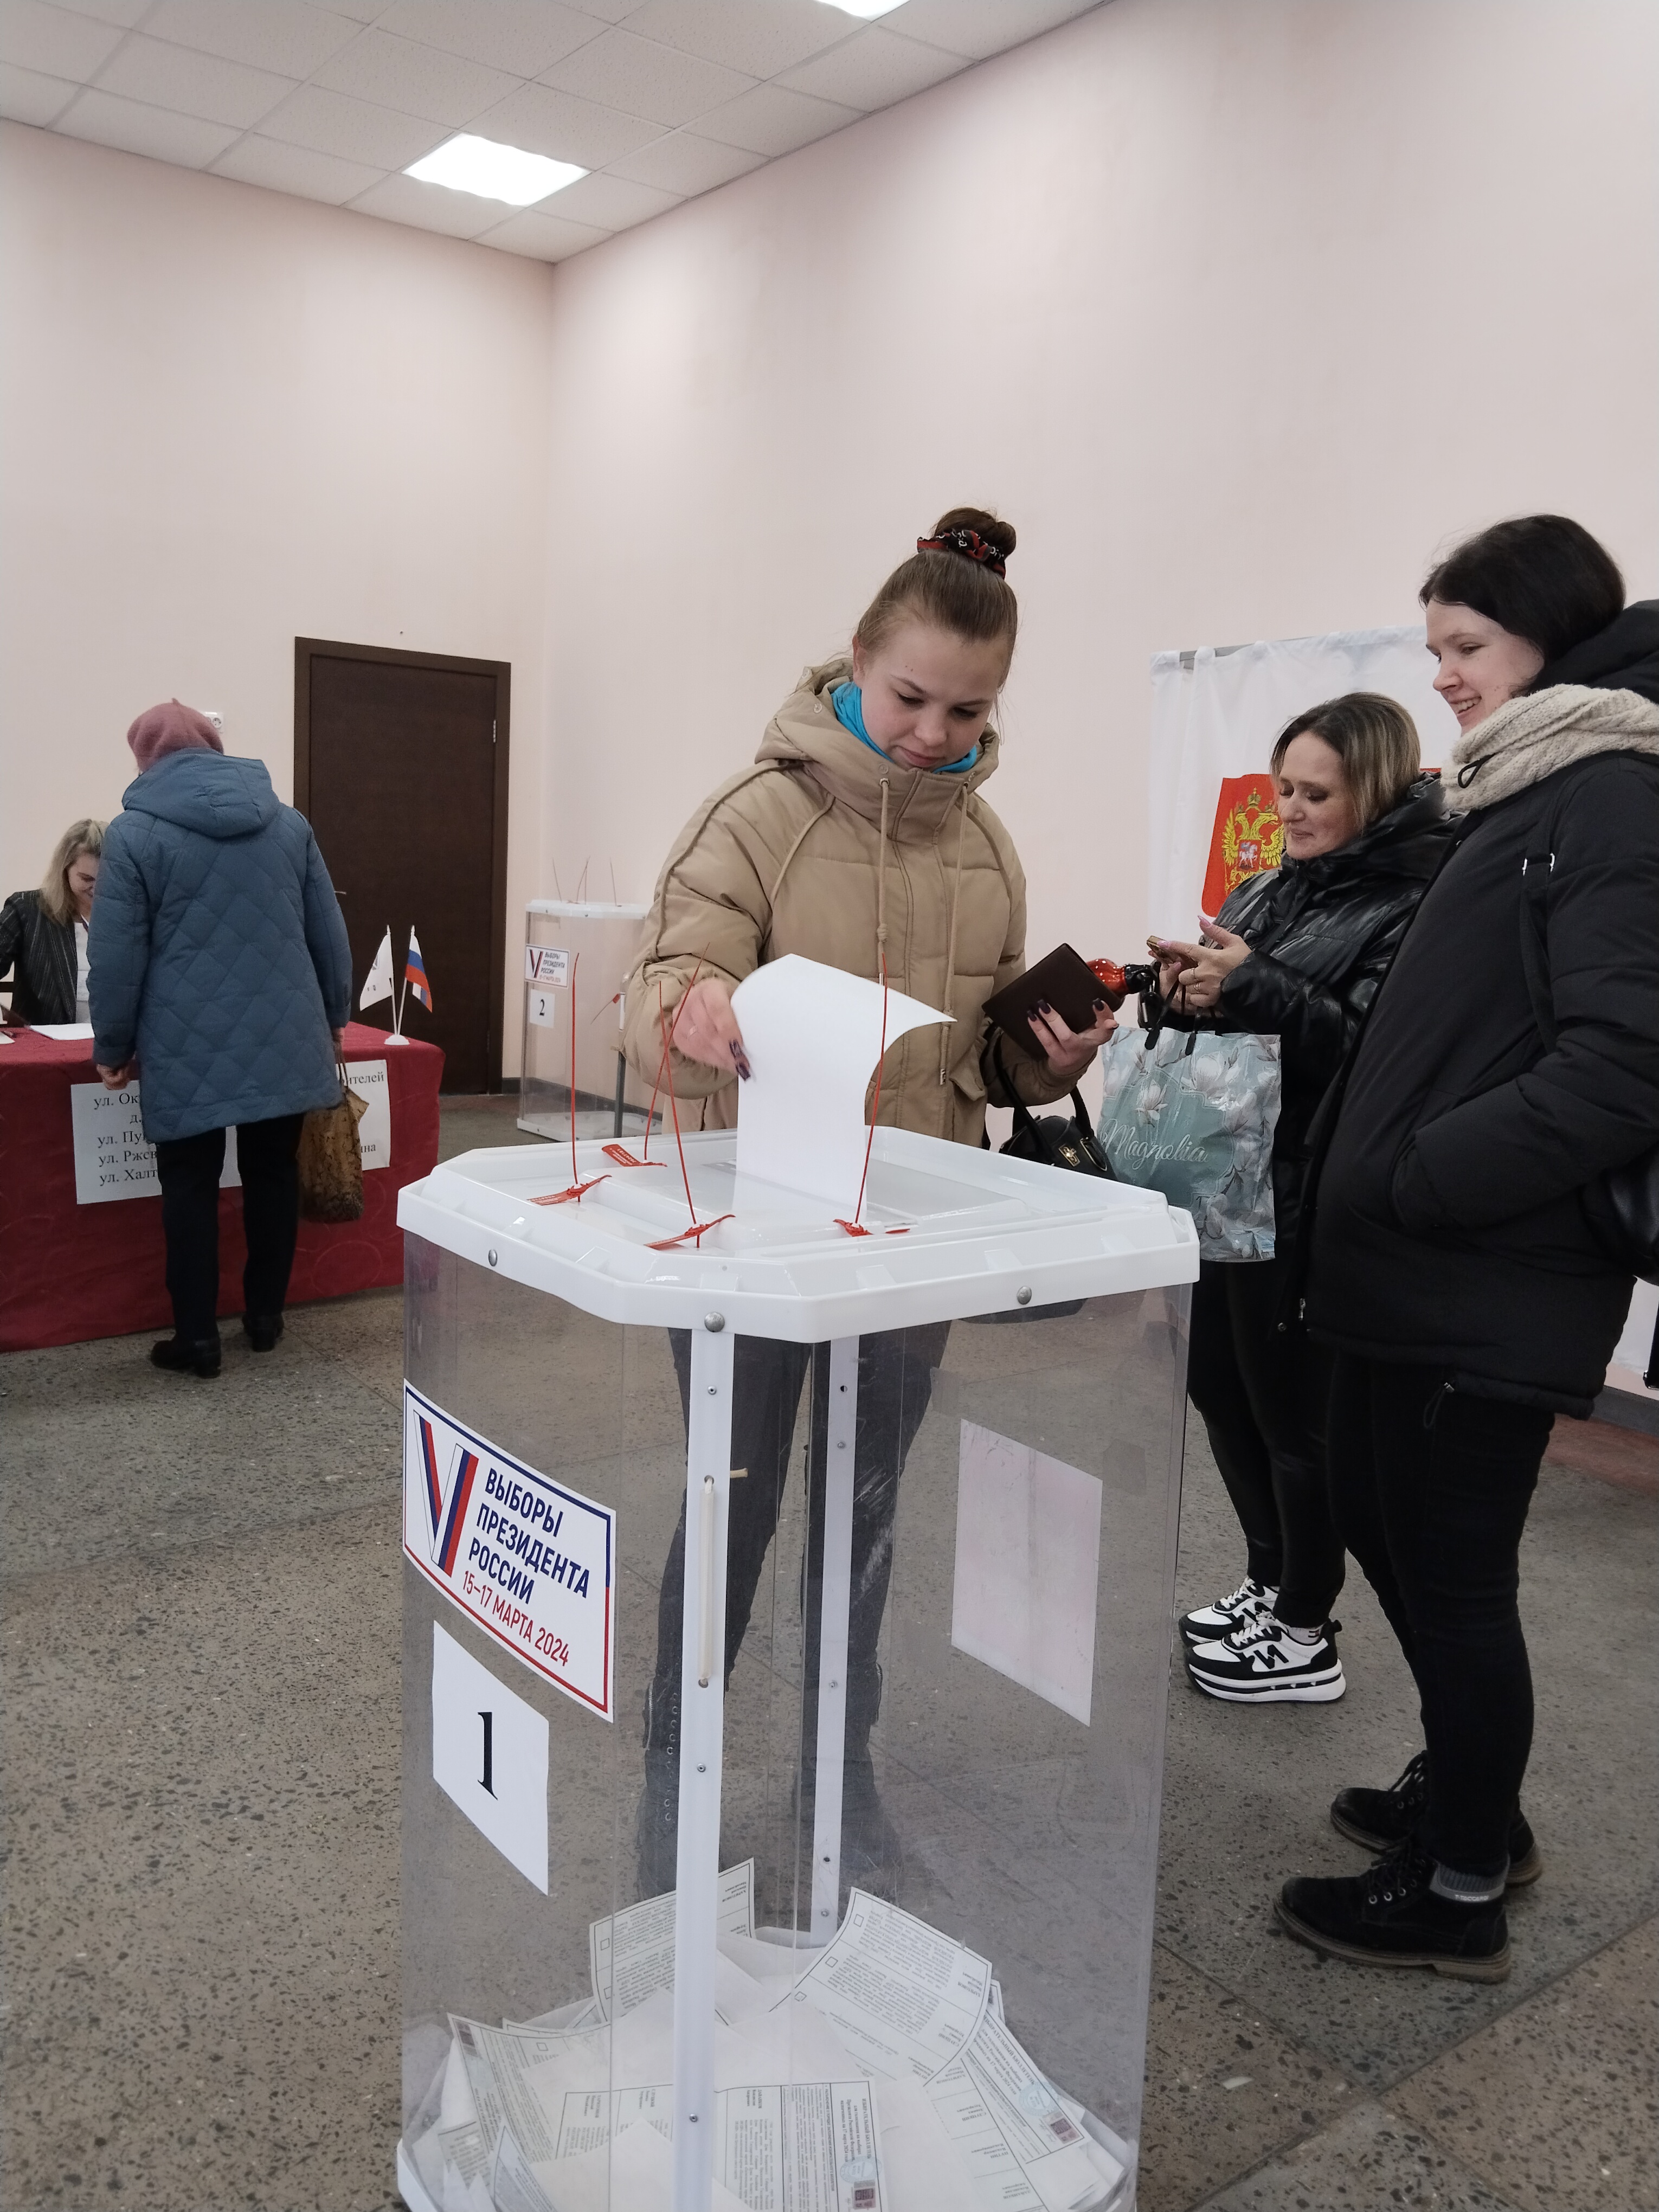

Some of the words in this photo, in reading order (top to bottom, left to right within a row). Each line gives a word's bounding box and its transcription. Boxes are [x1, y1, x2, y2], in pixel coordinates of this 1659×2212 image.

[543, 960, 565, 968] ПРЕЗИДЕНТА
[539, 999, 545, 1016] 2
[348, 1071, 384, 1084] ителей
[94, 1097, 114, 1110] ул.
[119, 1093, 140, 1104] Ок
[130, 1115, 142, 1124] д.
[98, 1136, 118, 1148] ул.
[123, 1131, 144, 1144] Пу
[1100, 1118, 1208, 1170] Magnolia
[99, 1155, 118, 1167] ул.
[124, 1150, 157, 1162] Ржев
[100, 1174, 119, 1186] ул.
[124, 1169, 158, 1181] Халт
[485, 1468, 563, 1537] ВЫБОРЫ
[476, 1503, 590, 1598] ПРЕЗИДЕНТА
[468, 1537, 535, 1605] РОССИИ
[492, 1594, 533, 1643] МАРТА
[535, 1627, 569, 1667] 2024
[477, 1712, 498, 1801] 1
